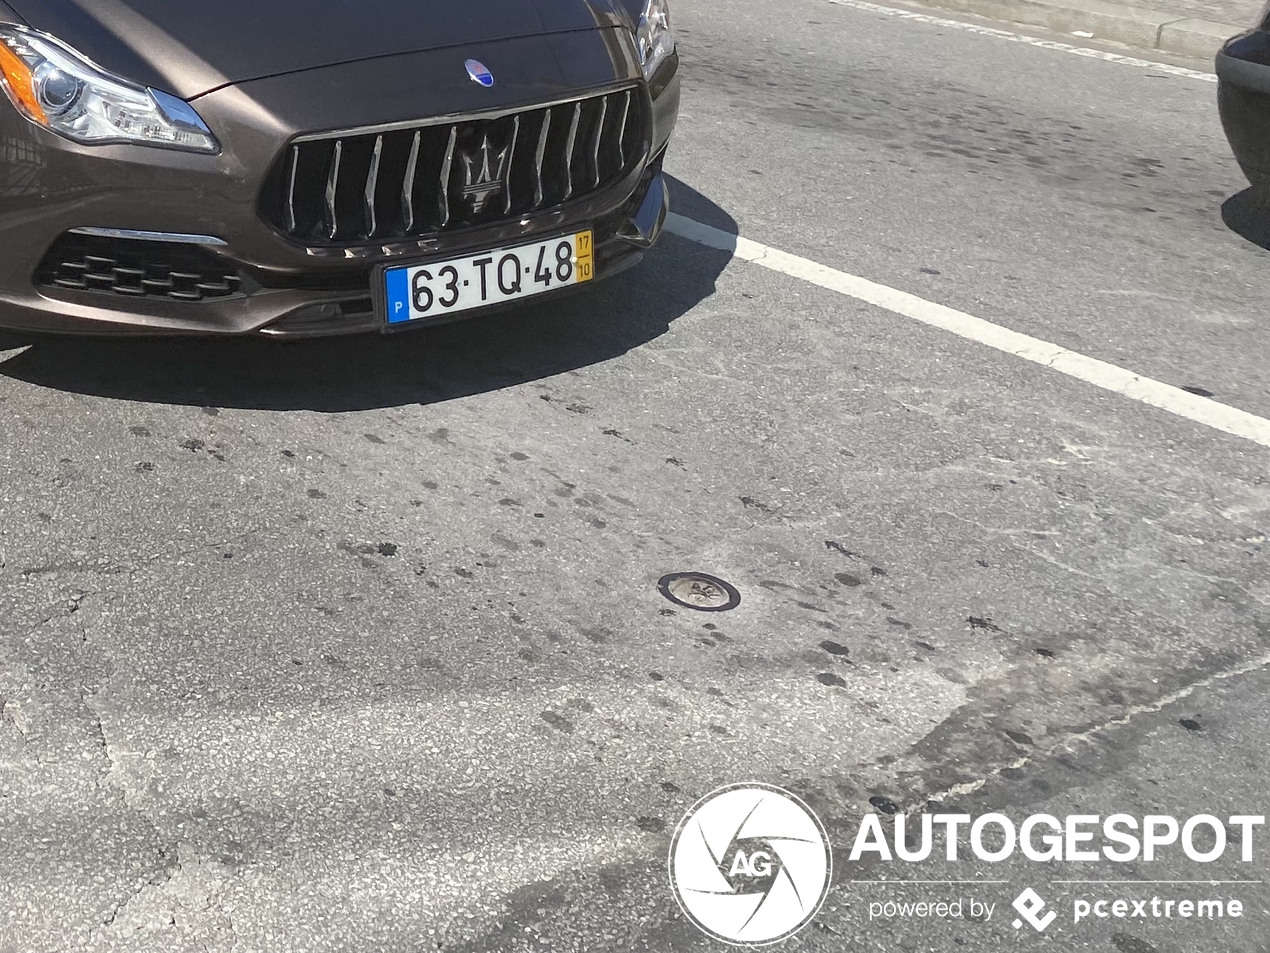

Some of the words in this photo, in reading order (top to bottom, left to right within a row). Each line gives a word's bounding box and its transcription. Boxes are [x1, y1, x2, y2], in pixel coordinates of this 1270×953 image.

[578, 235, 590, 250] 17
[579, 263, 590, 278] 10
[394, 301, 403, 313] P
